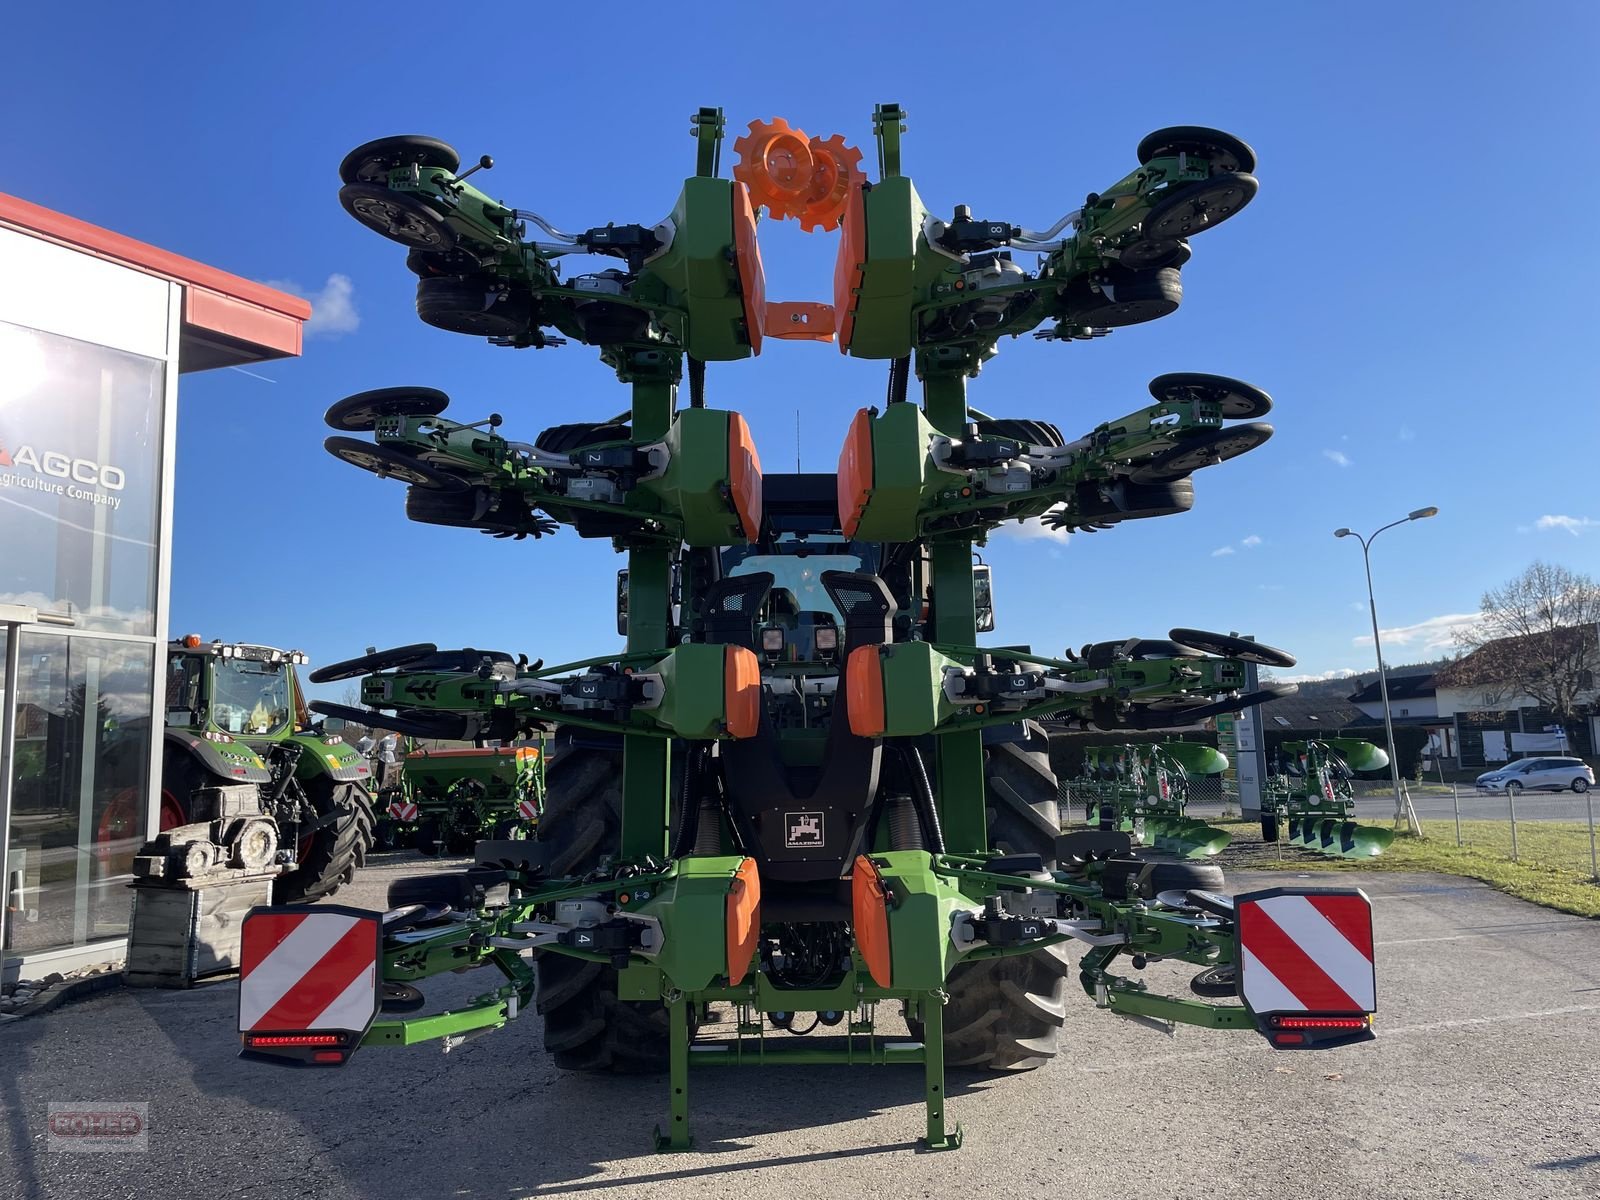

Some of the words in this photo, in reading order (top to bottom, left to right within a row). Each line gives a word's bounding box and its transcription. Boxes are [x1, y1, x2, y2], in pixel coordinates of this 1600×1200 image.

[990, 226, 1003, 234] 8
[999, 445, 1011, 453] 7
[589, 454, 602, 463] 2
[13, 445, 126, 491] AGCO
[0, 473, 64, 495] griculture
[67, 485, 121, 510] Company
[582, 686, 595, 694] 3
[1024, 926, 1038, 934] 5
[578, 934, 591, 943] 4
